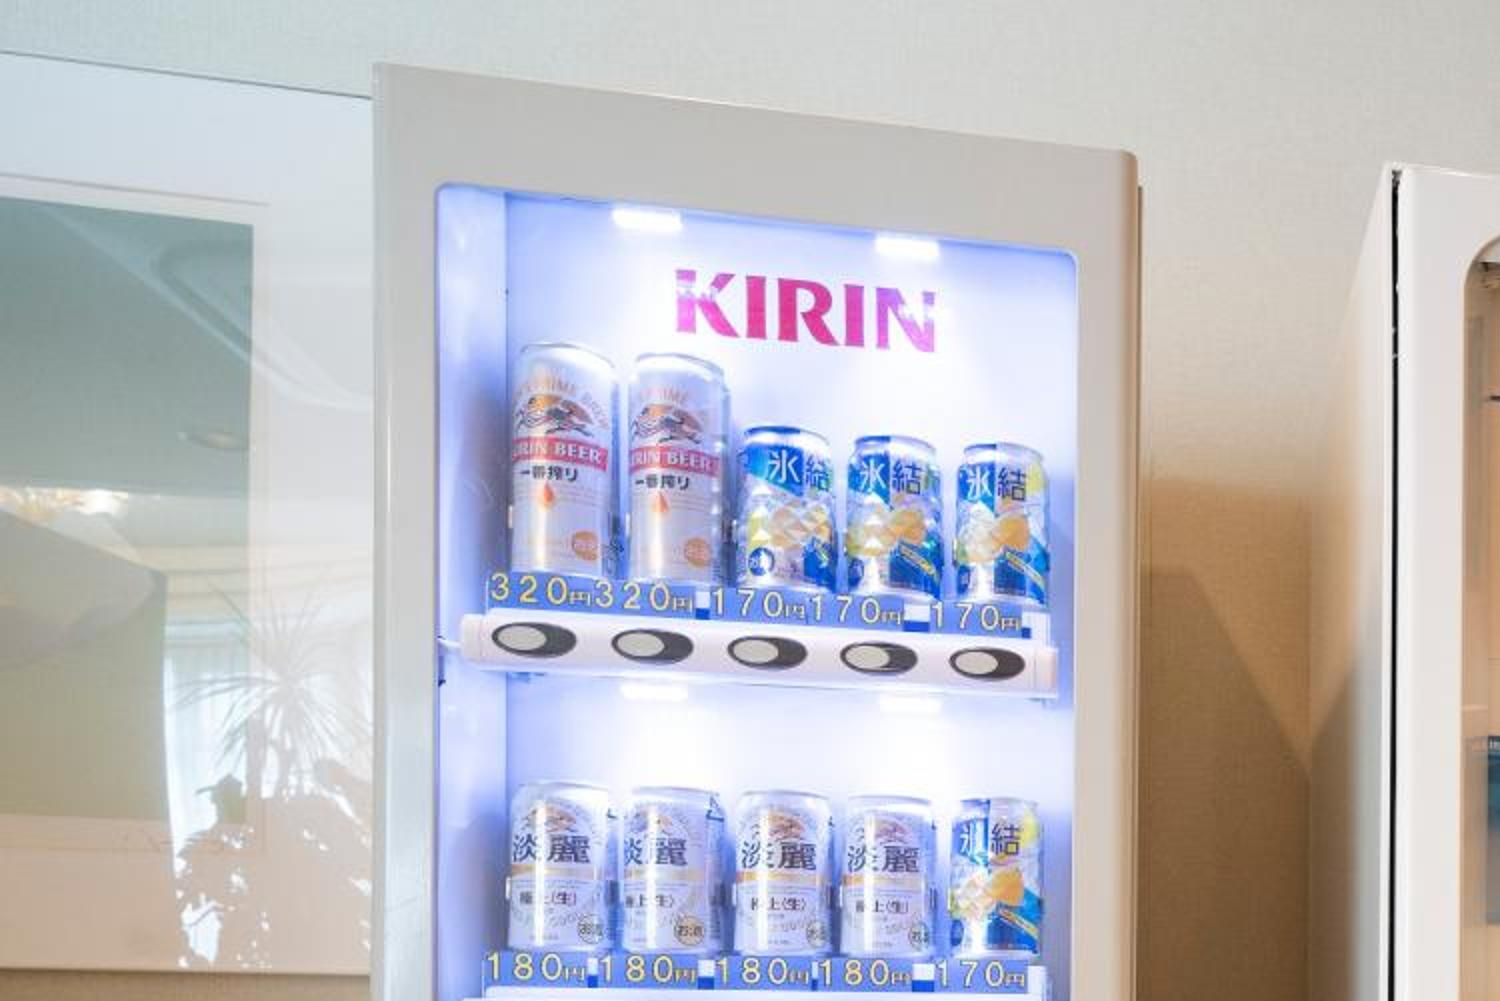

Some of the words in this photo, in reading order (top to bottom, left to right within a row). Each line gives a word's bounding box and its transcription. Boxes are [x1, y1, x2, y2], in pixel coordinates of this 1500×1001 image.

[675, 269, 936, 353] KIRIN
[555, 446, 602, 465] BEER
[668, 453, 714, 471] BEER
[520, 465, 578, 482] 一番搾り
[636, 474, 690, 491] 一番搾り
[767, 449, 829, 493] 氷結
[860, 458, 922, 494] 氷結
[966, 466, 1026, 502] 氷結
[491, 573, 591, 607] 320円
[596, 581, 693, 613] 320円
[711, 588, 805, 618] 170円
[811, 593, 901, 625] 170円
[931, 602, 1022, 632] 170円
[512, 833, 591, 864] 淡麗
[959, 823, 1022, 857] 氷結
[741, 840, 817, 872] 淡麗
[847, 845, 920, 874] 淡麗
[487, 953, 586, 981] 180円
[601, 955, 696, 982] 180円
[716, 955, 809, 985] 180円
[822, 959, 912, 986] 180円
[936, 960, 1025, 988] 170円
